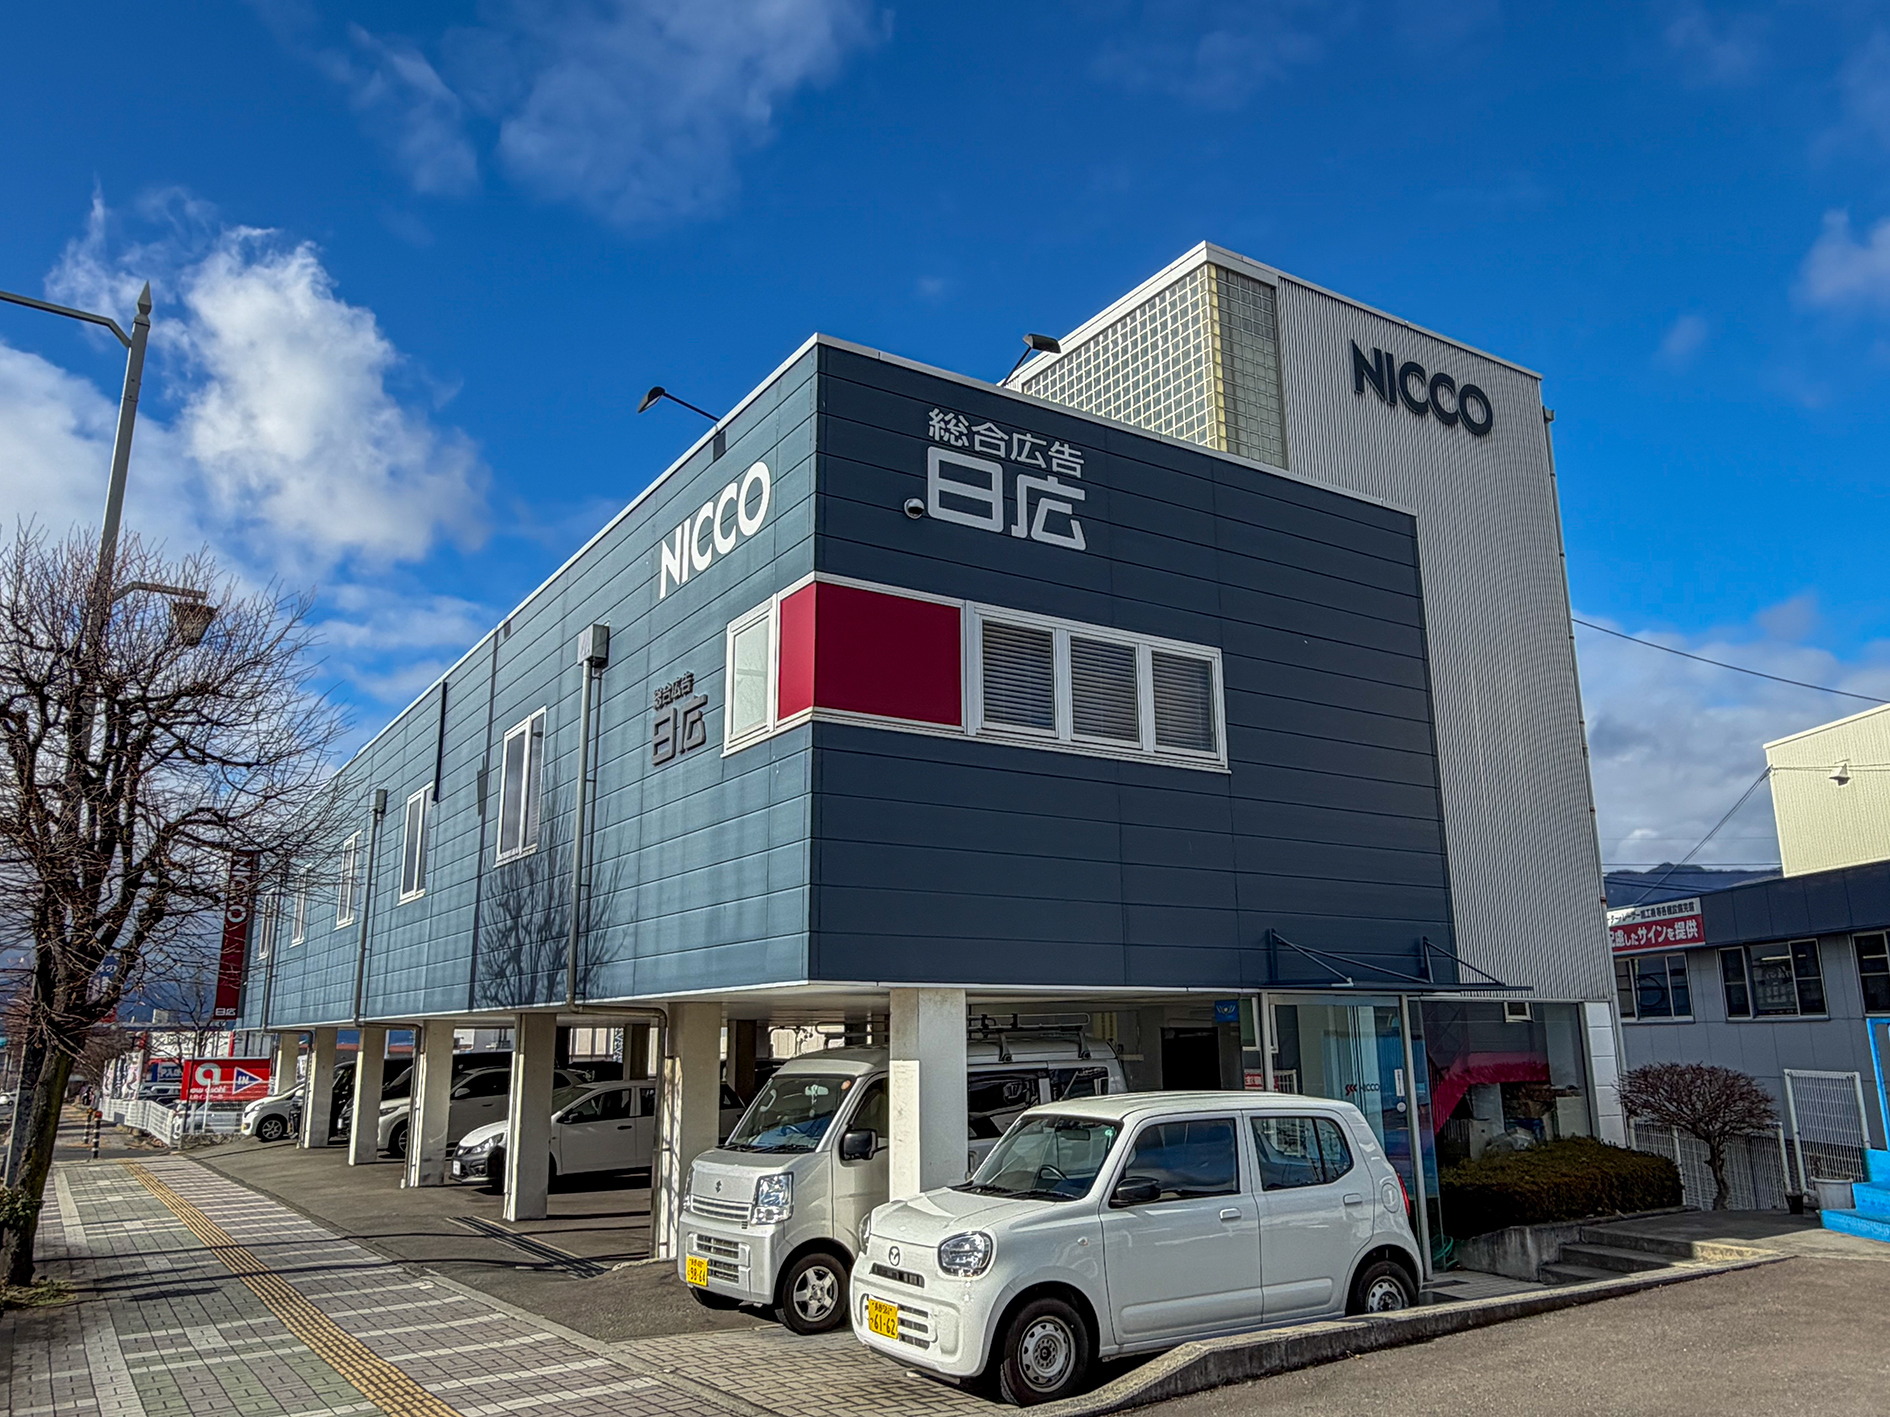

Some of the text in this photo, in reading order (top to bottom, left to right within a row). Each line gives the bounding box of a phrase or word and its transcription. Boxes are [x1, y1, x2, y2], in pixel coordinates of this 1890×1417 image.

[1350, 339, 1493, 435] NICCO
[928, 408, 1085, 478] 総合広告
[659, 461, 771, 600] NICCO
[927, 446, 1087, 550] 日広
[652, 694, 708, 766] 日広
[874, 1314, 896, 1336] 61-62
